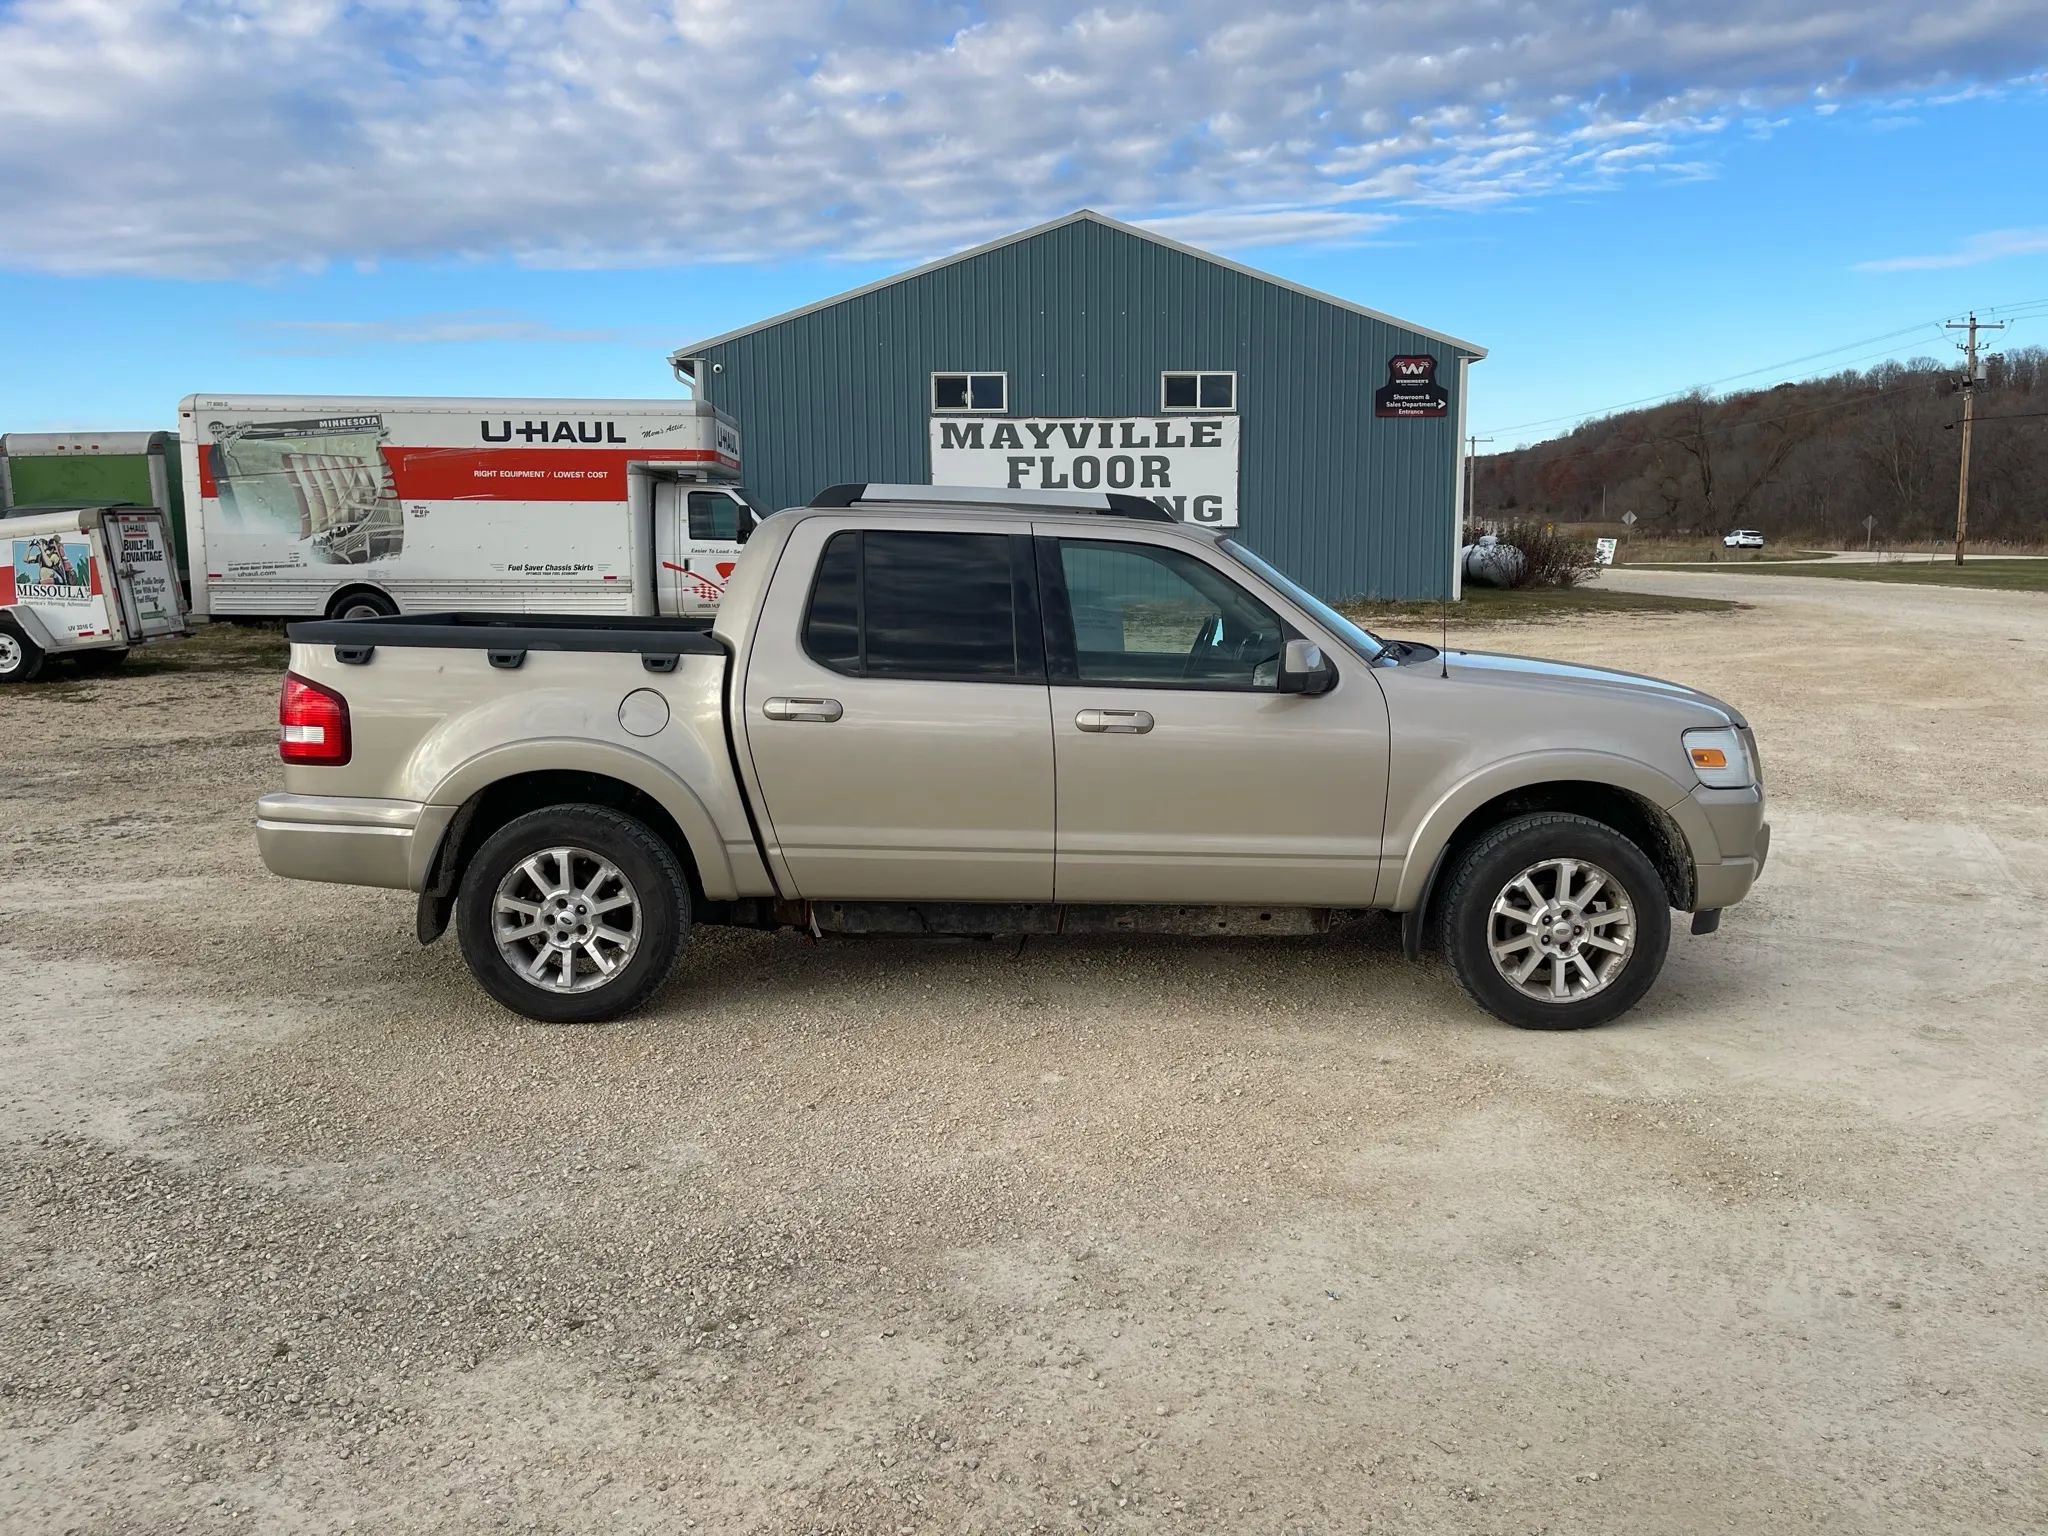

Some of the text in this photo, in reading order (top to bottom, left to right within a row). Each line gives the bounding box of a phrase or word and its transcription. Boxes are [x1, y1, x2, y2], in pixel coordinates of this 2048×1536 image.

[319, 416, 379, 428] MINNESOTA
[940, 421, 1223, 449] MAYVILLE
[474, 470, 497, 478] RIGHT
[500, 470, 545, 478] EQUIPMENT
[1007, 455, 1171, 489] FLOOR
[121, 551, 162, 562] ADVANTAGE
[17, 585, 84, 599] MISSOULA
